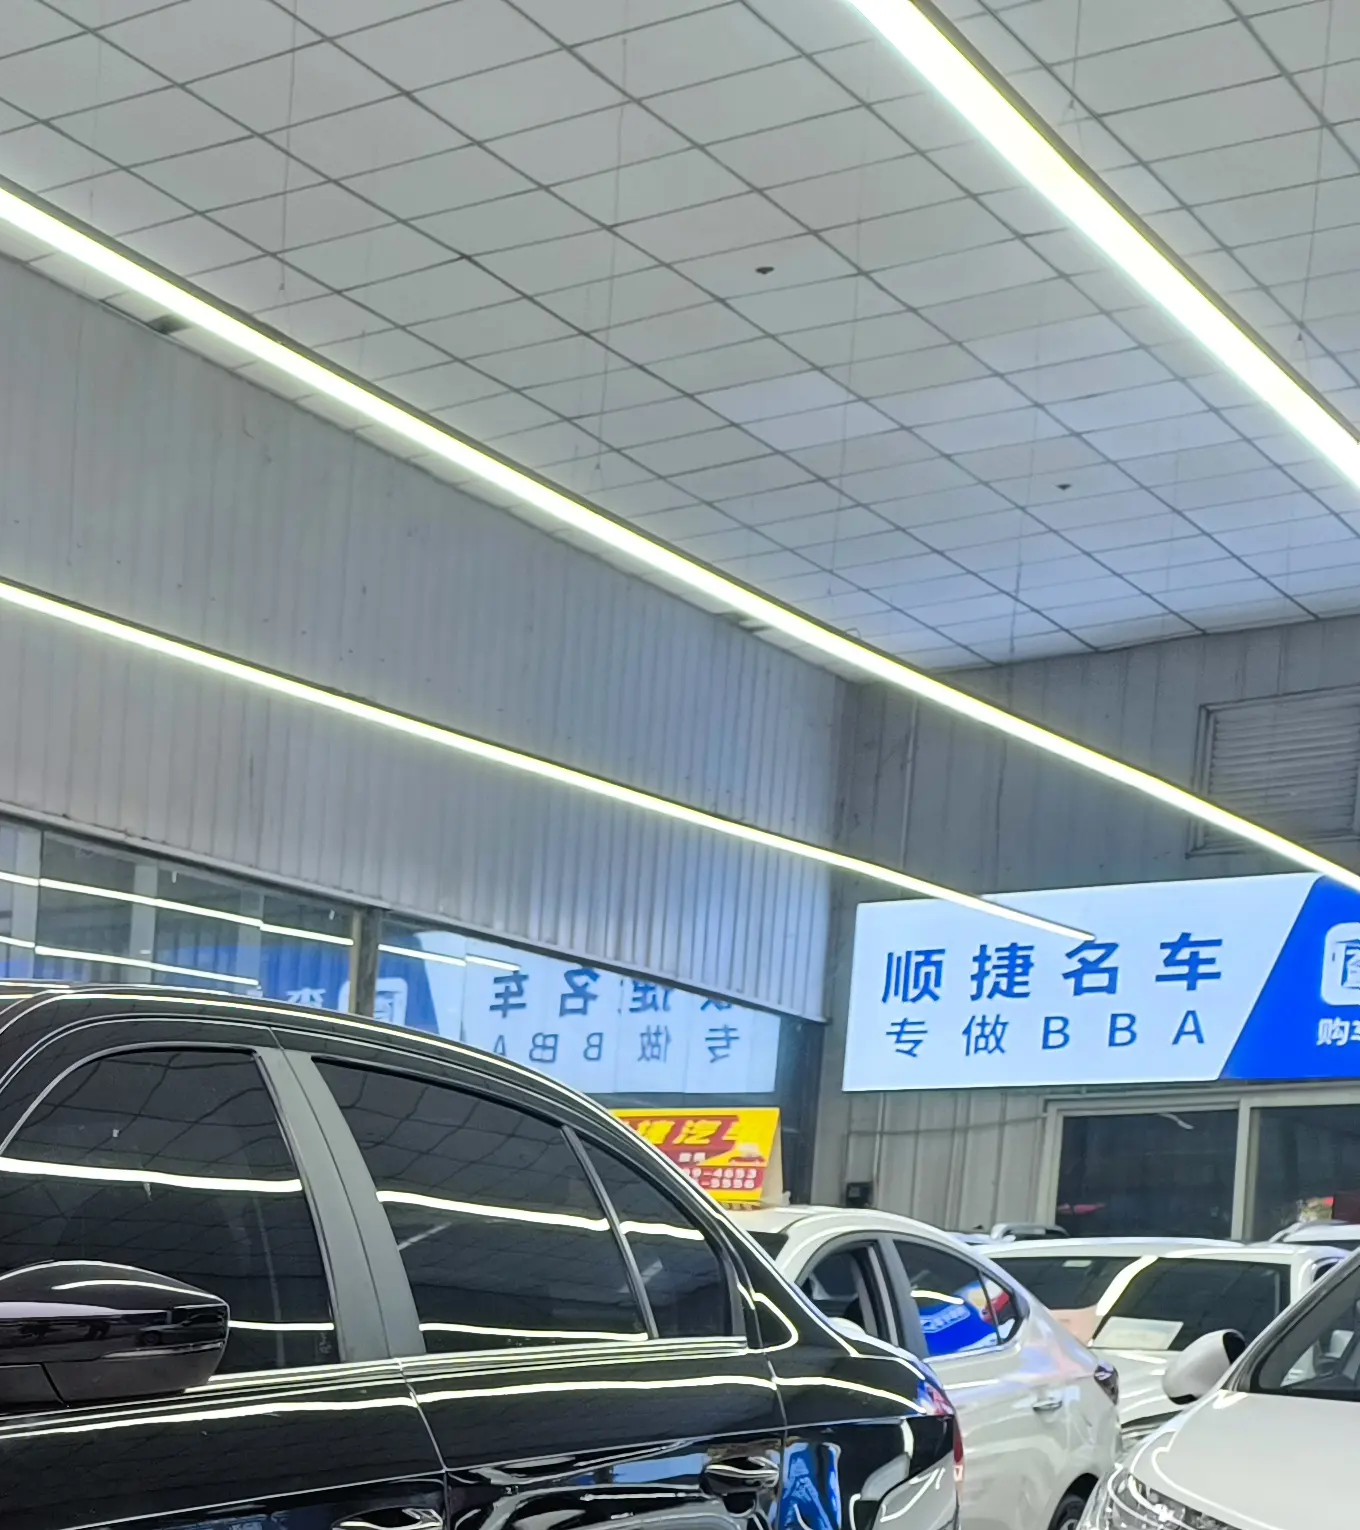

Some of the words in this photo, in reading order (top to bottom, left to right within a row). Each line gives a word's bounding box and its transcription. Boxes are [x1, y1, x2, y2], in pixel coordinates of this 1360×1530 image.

[881, 932, 1223, 1004] 顺捷名车
[885, 1009, 1206, 1058] 专做BBA
